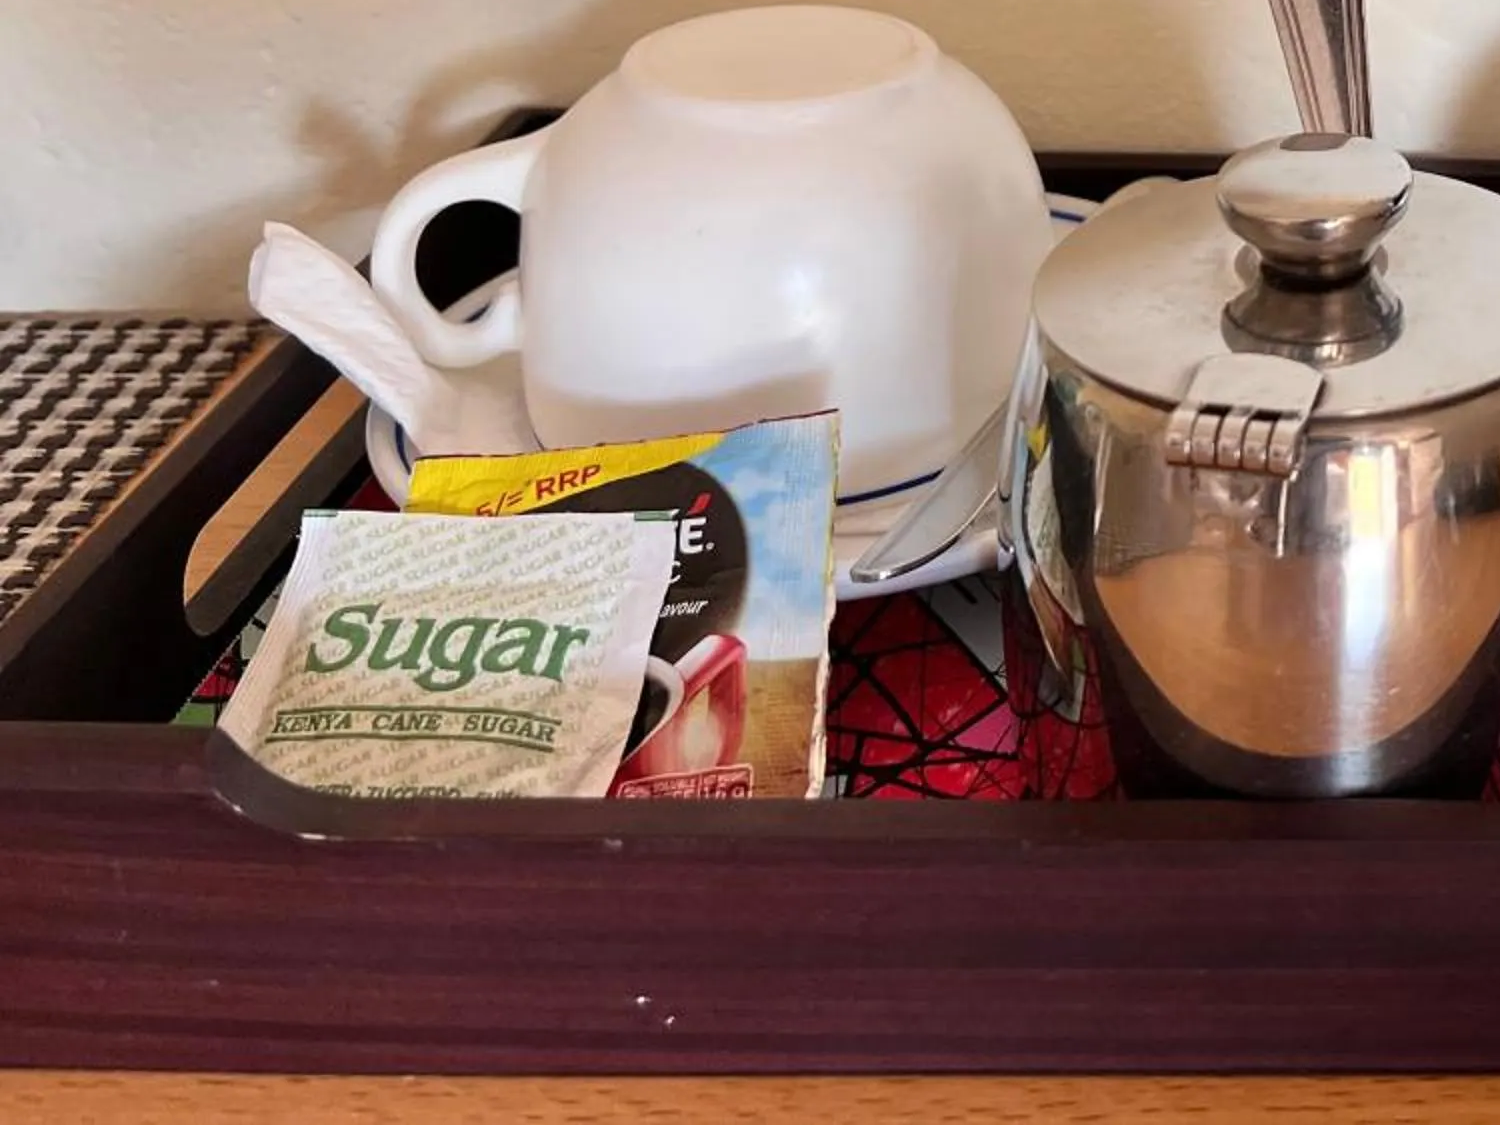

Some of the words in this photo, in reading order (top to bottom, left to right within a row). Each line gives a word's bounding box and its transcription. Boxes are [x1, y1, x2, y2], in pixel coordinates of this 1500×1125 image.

[535, 463, 602, 500] RRP
[304, 602, 590, 692] Sugar
[272, 713, 352, 733] KENYA
[371, 713, 442, 732] CANE
[462, 715, 556, 743] SUGAR
